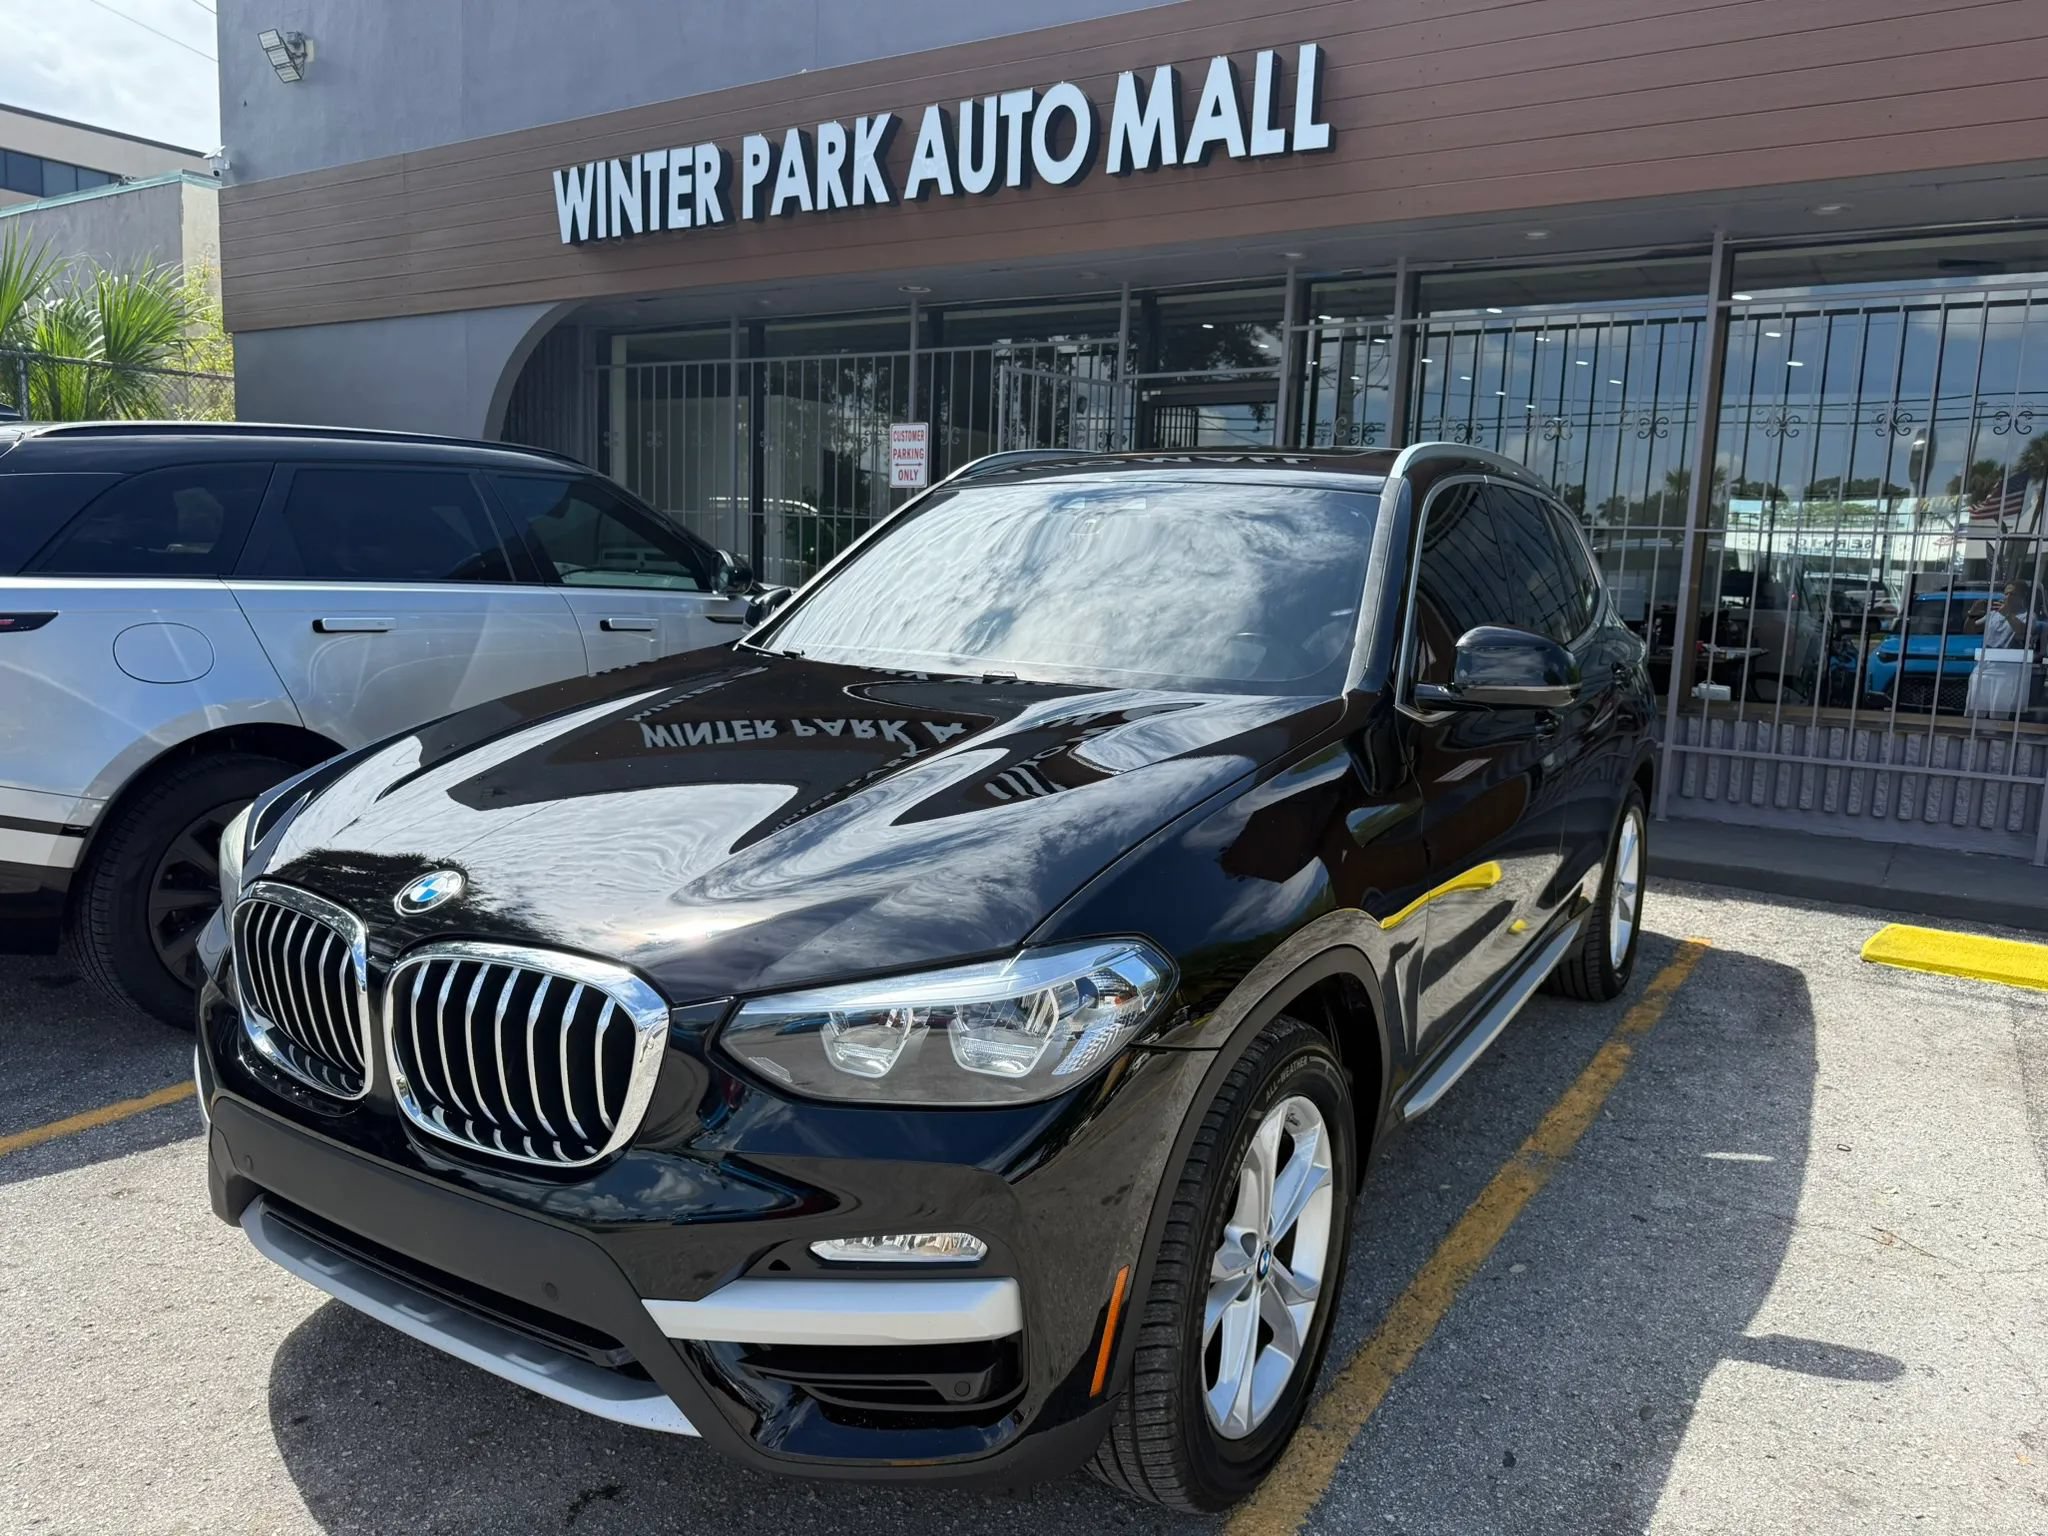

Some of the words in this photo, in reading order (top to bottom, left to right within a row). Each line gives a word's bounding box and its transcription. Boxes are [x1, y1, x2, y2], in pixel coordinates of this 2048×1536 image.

[552, 141, 726, 245] WINTER
[741, 112, 896, 220] PARK
[902, 81, 1092, 200] AUTO
[1105, 42, 1332, 175] MALL
[892, 430, 925, 442] CUSTOMER
[892, 447, 925, 459] PARKING
[897, 468, 919, 481] ONLY
